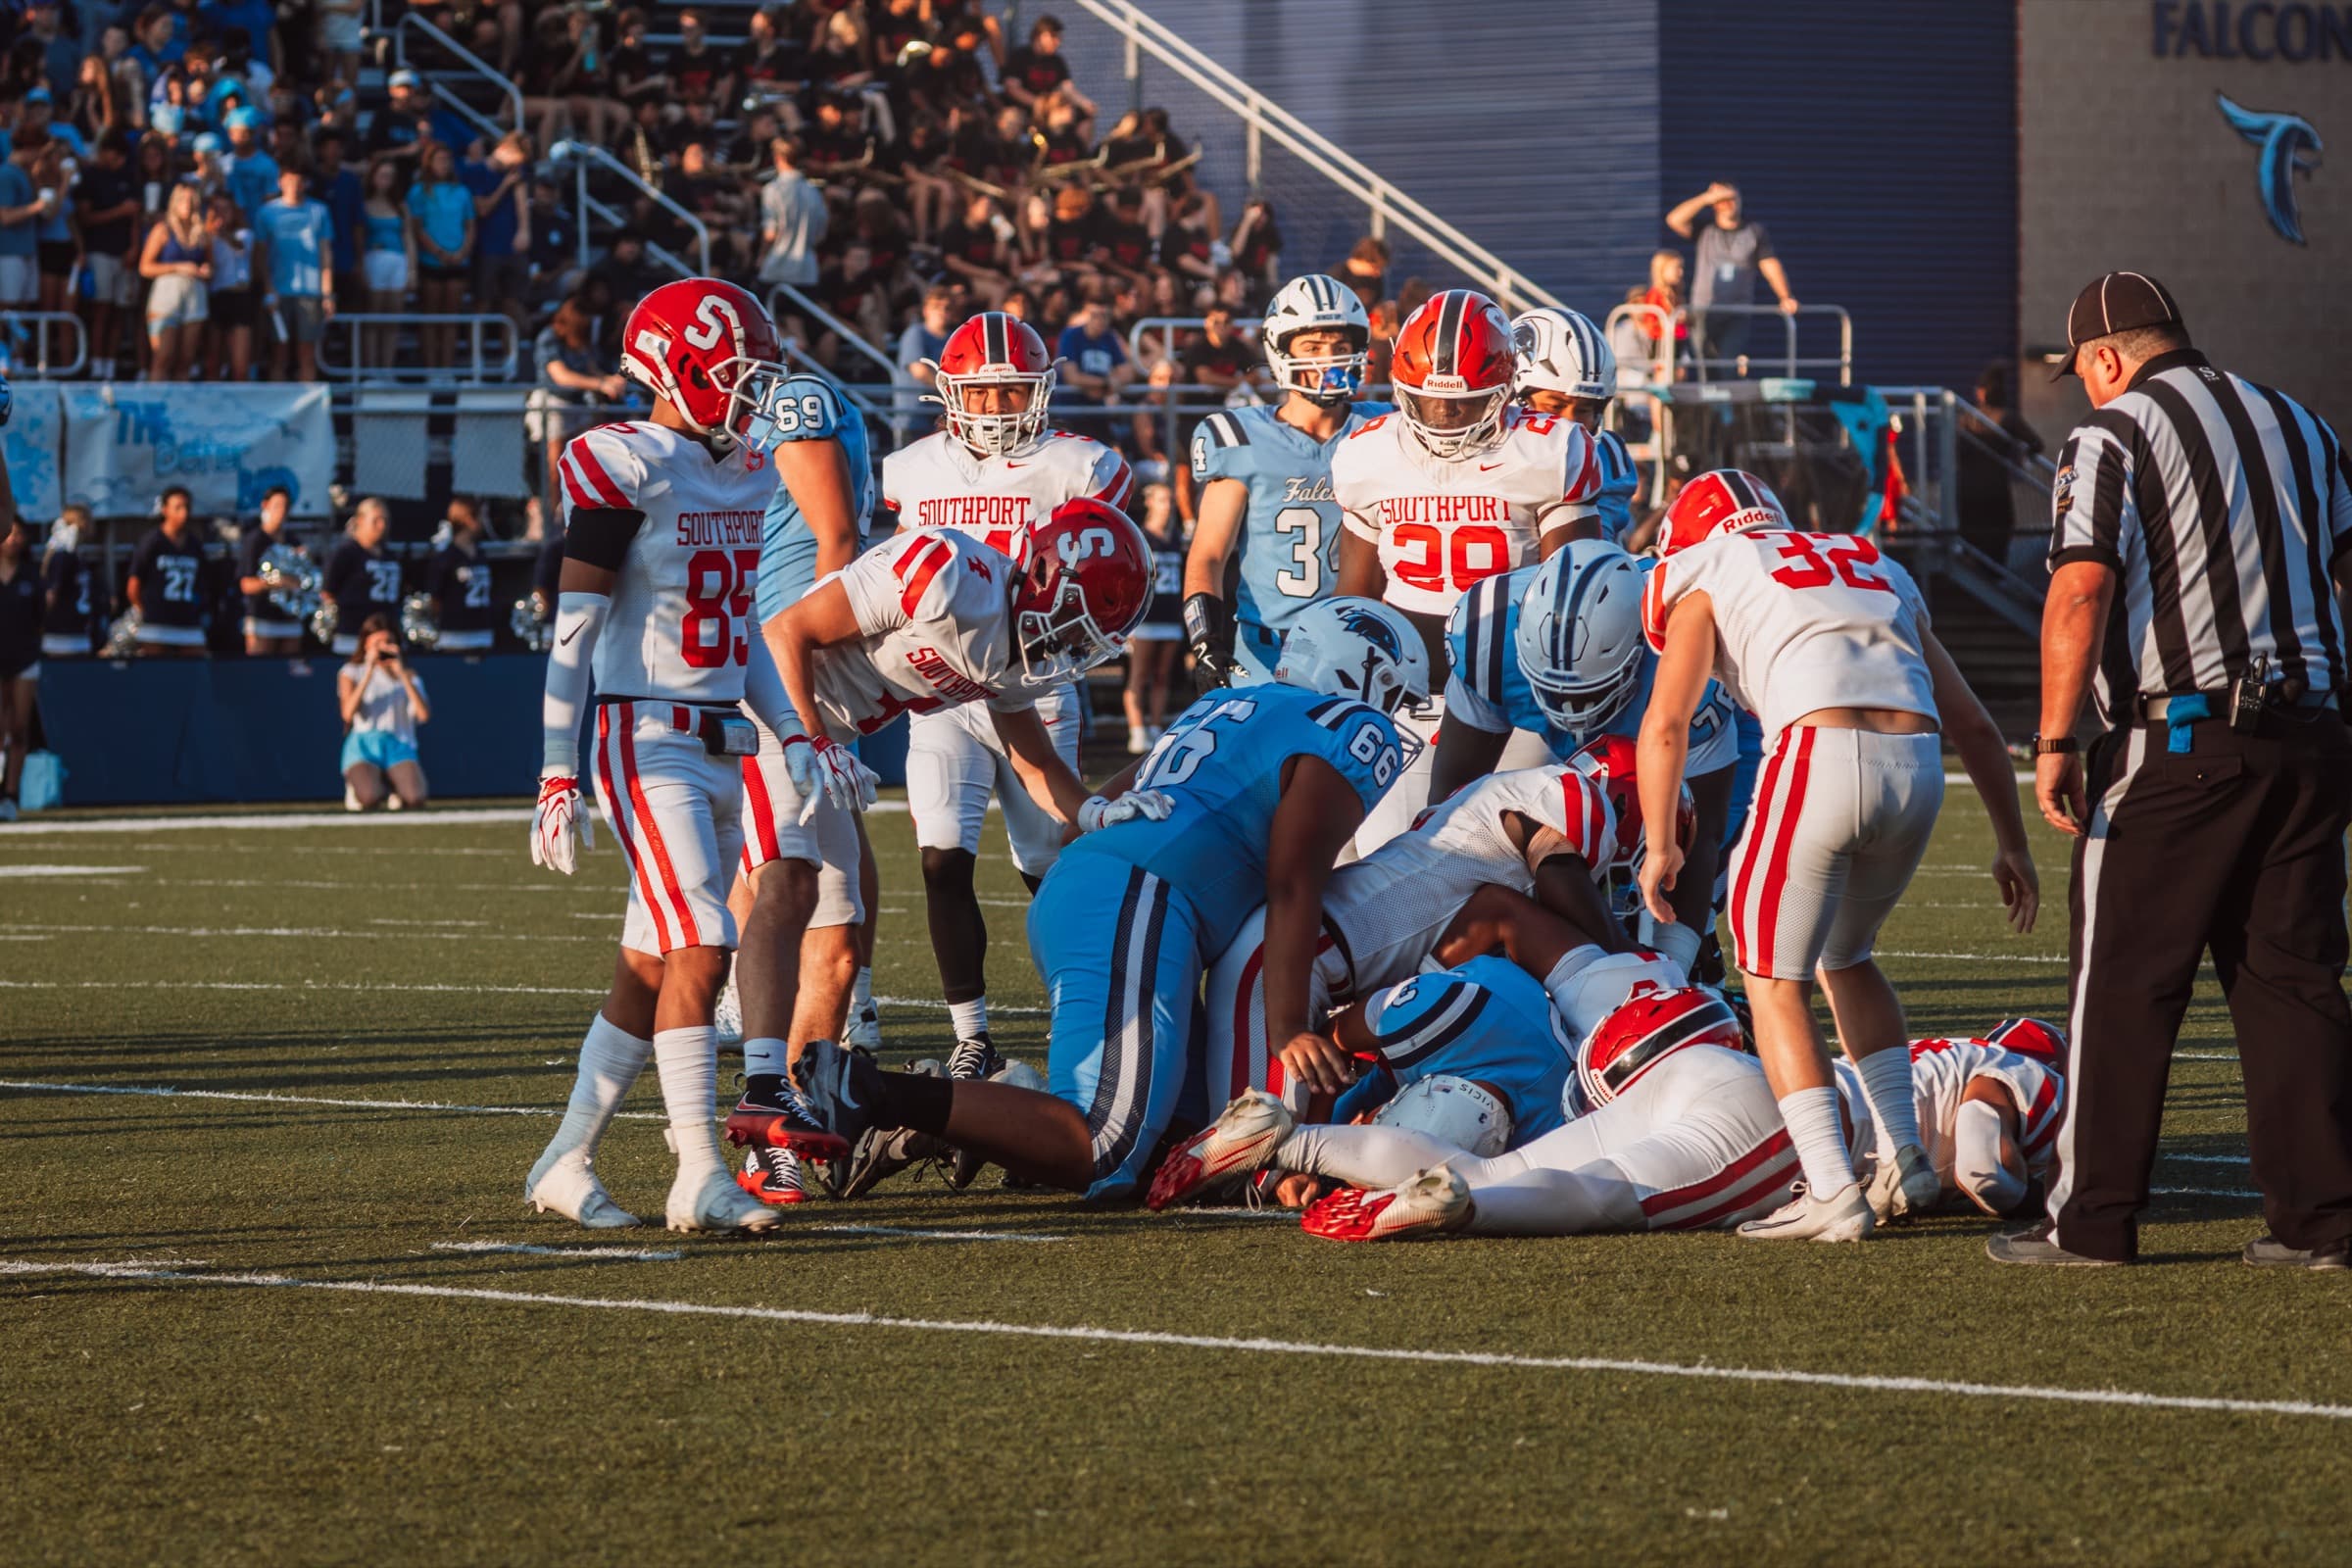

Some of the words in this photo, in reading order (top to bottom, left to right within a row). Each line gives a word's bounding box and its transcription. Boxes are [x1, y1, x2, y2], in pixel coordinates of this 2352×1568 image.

[2152, 0, 2352, 62] FALCON
[774, 394, 824, 432] 69
[1427, 378, 1463, 390] Riddell
[918, 497, 1031, 526] SOUTHPORT
[1722, 510, 1784, 534] Riddell
[1275, 507, 1340, 599] 3
[1742, 532, 1896, 594] 32
[681, 549, 761, 668] 85
[1133, 698, 1258, 793] 66
[1348, 721, 1399, 788] 66
[1458, 1083, 1494, 1110] VICIS
